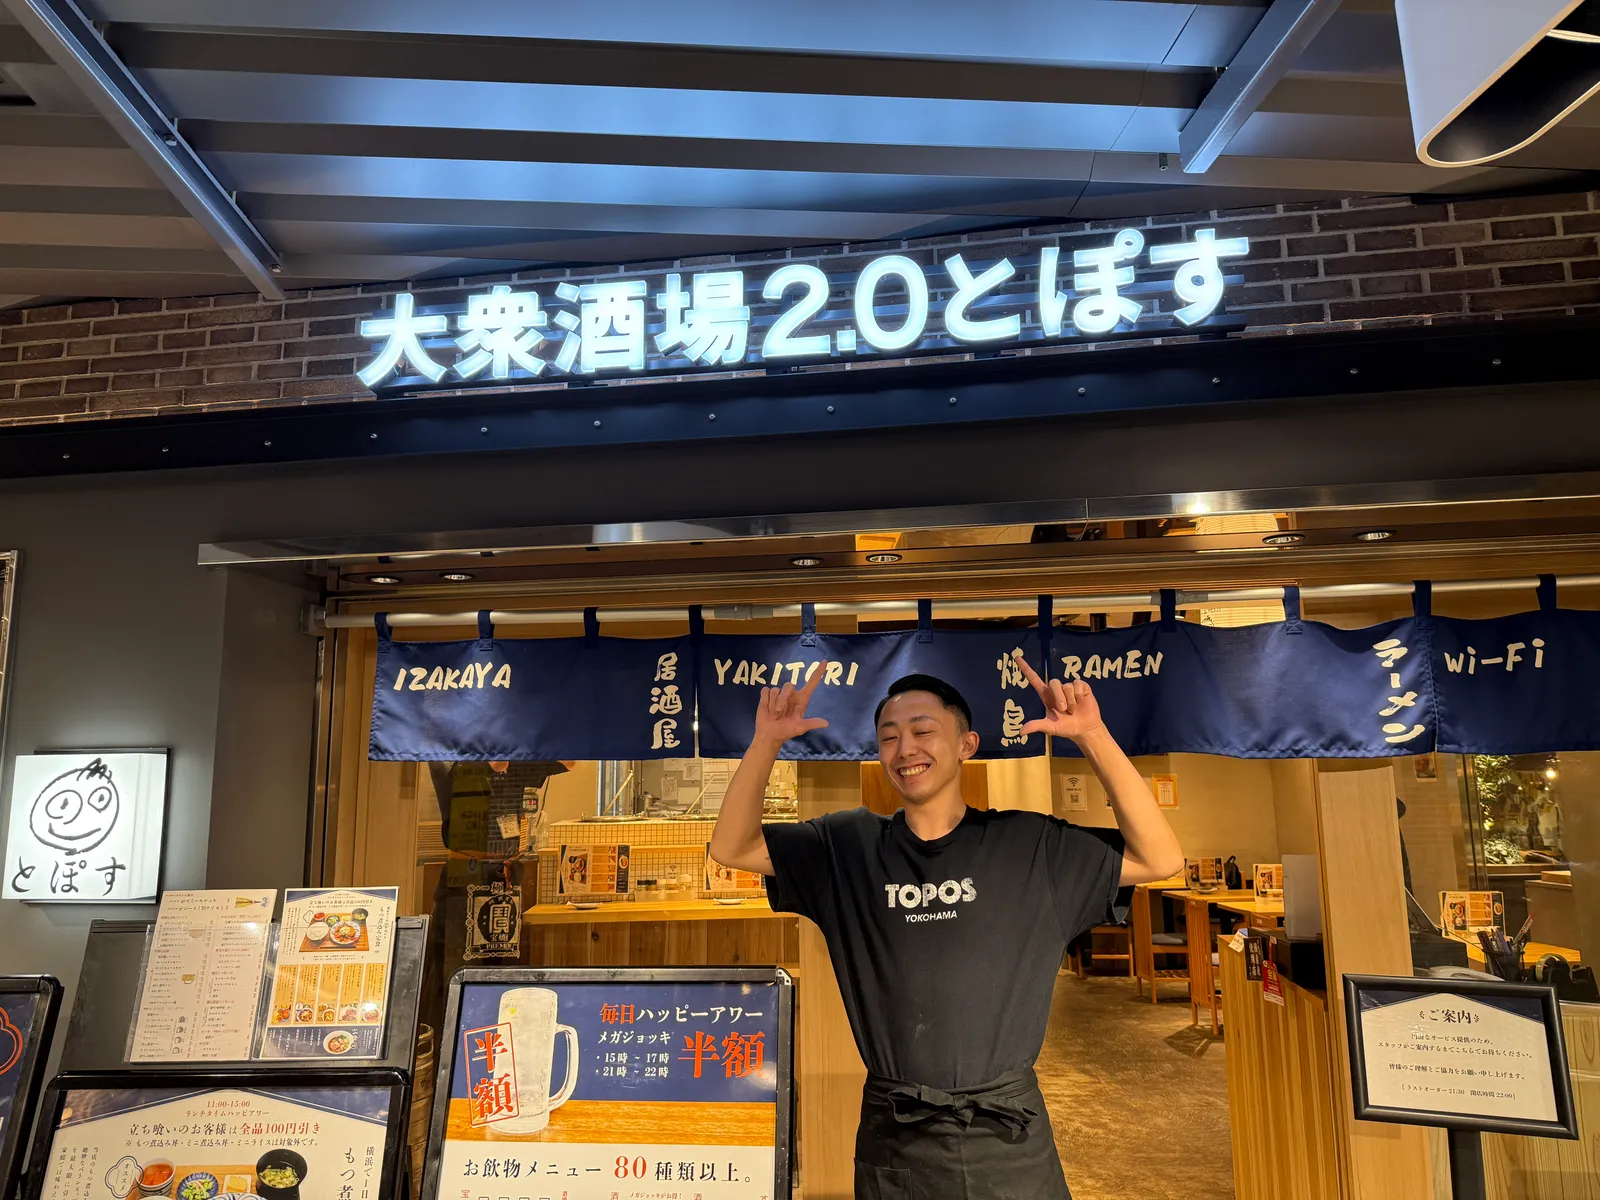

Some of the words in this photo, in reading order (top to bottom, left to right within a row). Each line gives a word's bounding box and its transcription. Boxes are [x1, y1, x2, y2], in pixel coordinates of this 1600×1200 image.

[356, 228, 1250, 387] 大衆酒場2.0とぽす
[393, 662, 512, 691] IZAKAYA
[1061, 649, 1164, 680] RAMEN
[648, 651, 683, 750] 居酒屋
[1372, 638, 1426, 744] ラーメン
[11, 856, 127, 896] とぽす
[884, 877, 978, 909] TOPOS
[905, 910, 958, 923] YOKOHAMA
[599, 1002, 764, 1024] 毎日ハッピーアワー
[1428, 1009, 1472, 1025] ご案内
[597, 1030, 671, 1045] メガジョッキ
[678, 1031, 766, 1079] 半額
[472, 1031, 515, 1119] 半額
[83, 1146, 99, 1200] 当店のもつ煮込
